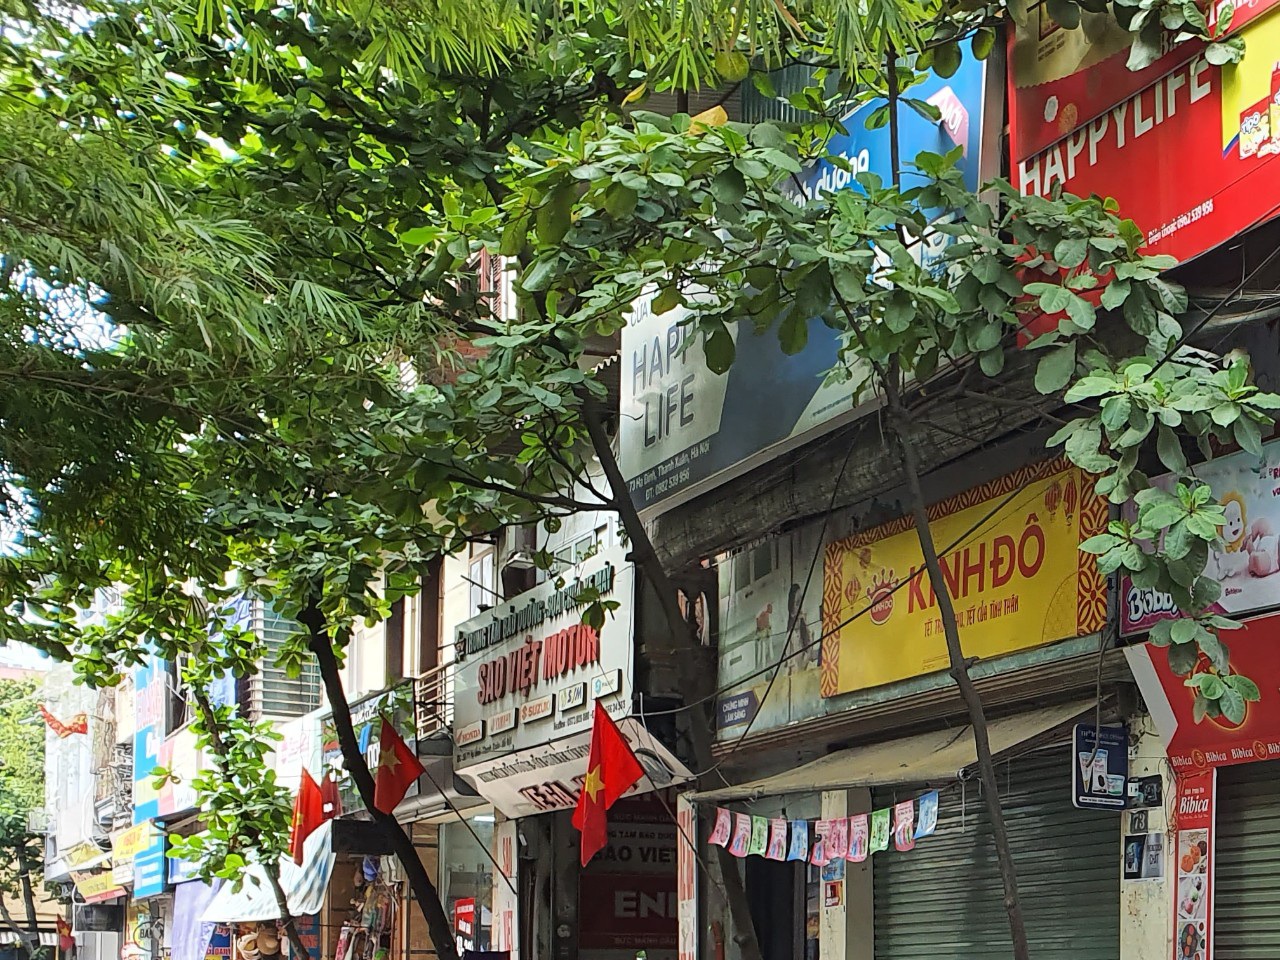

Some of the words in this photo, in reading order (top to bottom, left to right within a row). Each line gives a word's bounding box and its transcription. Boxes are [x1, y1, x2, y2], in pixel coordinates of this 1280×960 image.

[644, 373, 695, 447] LIFE
[989, 513, 1045, 587] ĐÔ
[477, 656, 506, 705] SAO
[508, 635, 542, 697] VIỆT
[1171, 755, 1193, 767] Bibica
[1205, 751, 1227, 763] Bibica
[1231, 748, 1254, 760] Bibica
[1180, 796, 1208, 814] Bibica
